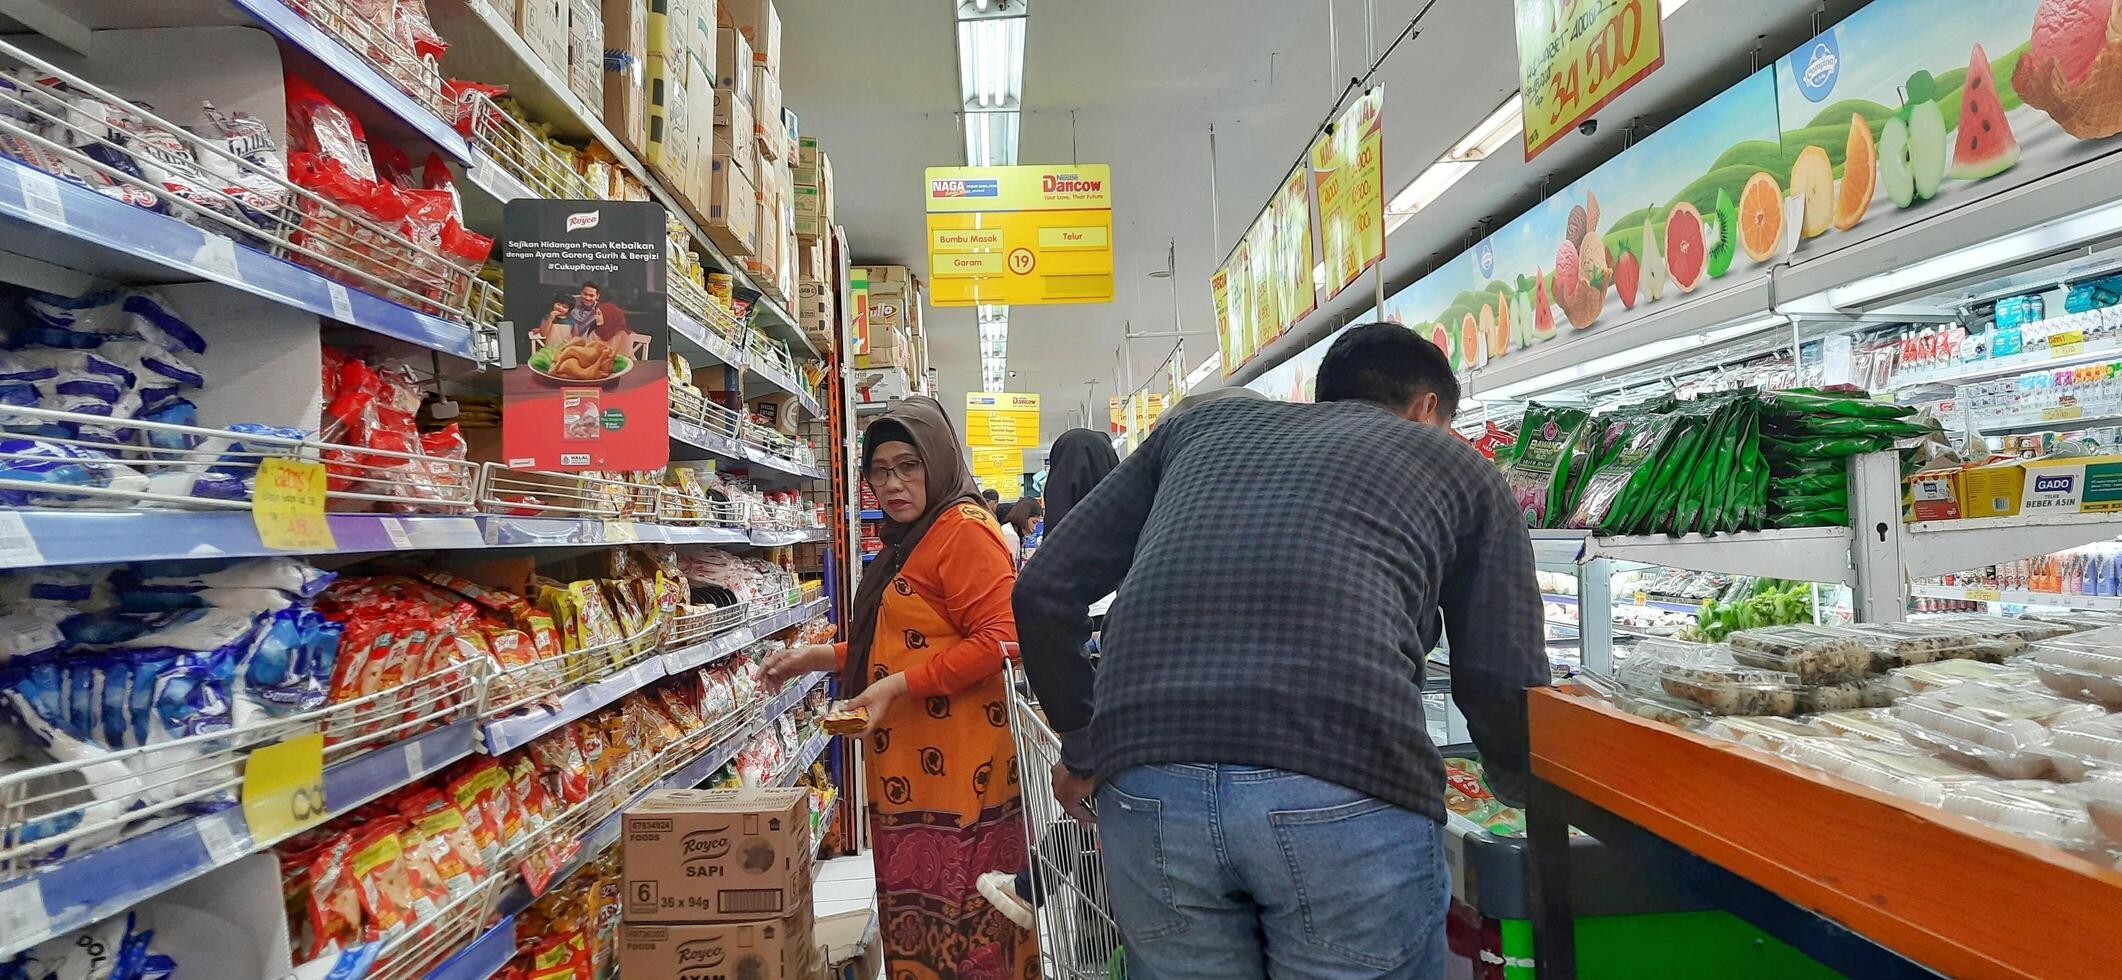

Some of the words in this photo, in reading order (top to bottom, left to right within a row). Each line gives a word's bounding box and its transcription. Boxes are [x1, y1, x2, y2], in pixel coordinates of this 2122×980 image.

[933, 181, 965, 191] NAGA
[1043, 175, 1101, 193] Dancow
[569, 216, 597, 226] Royco
[940, 235, 969, 243] Bumbu
[970, 234, 998, 243] Masak
[1062, 232, 1083, 241] Telur
[508, 240, 540, 250] Sajikan
[540, 241, 581, 250] Hidangan
[582, 241, 607, 249] Penuh
[609, 241, 655, 250] Kebaikan
[506, 251, 534, 259] dengan
[535, 251, 560, 260] Ayam
[562, 251, 594, 261] Goreng
[595, 251, 619, 260] Gurih
[620, 252, 627, 260] &
[629, 252, 660, 261] Bergizi
[954, 259, 982, 267] Garam
[1014, 255, 1030, 268] 19
[548, 263, 619, 272] #CukupRoycoAja
[2038, 479, 2069, 490] GADO
[2026, 500, 2053, 508] BEBEK
[2055, 499, 2076, 507] ASIN
[630, 834, 660, 842] FOODS
[683, 837, 729, 855] Royco
[686, 866, 724, 877] SAPI
[638, 884, 651, 902] 6
[660, 897, 673, 908] 36
[678, 899, 685, 908] x
[688, 896, 709, 910] 94g
[678, 946, 723, 965] Royco
